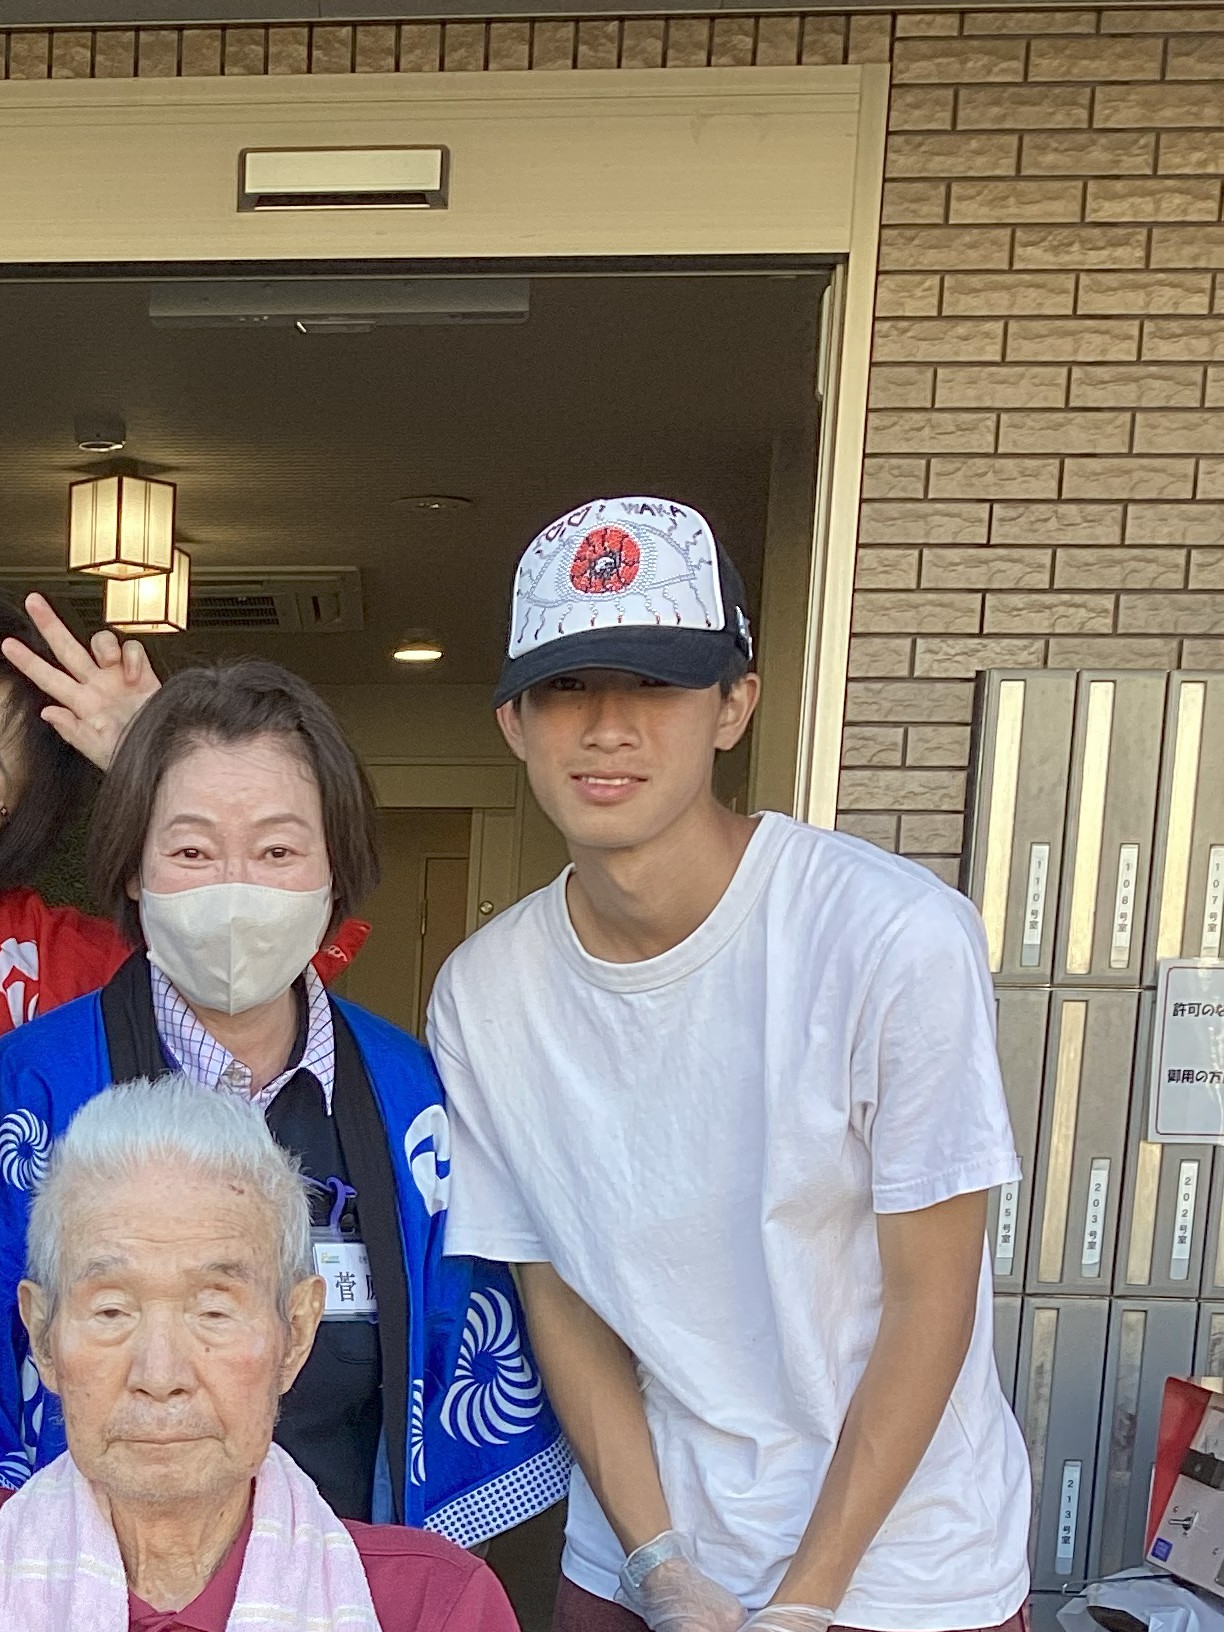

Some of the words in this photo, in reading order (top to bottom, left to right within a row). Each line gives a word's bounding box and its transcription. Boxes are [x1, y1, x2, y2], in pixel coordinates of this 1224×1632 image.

[1029, 860, 1042, 930] 110号室
[1117, 863, 1131, 932] 108号室
[1207, 863, 1220, 932] 107号室
[1167, 1069, 1224, 1084] 御用の方
[1001, 1182, 1014, 1243] 05号室
[1087, 1183, 1101, 1250] 203号室
[1178, 1177, 1191, 1244] 202号室
[1061, 1480, 1074, 1544] 213号室
